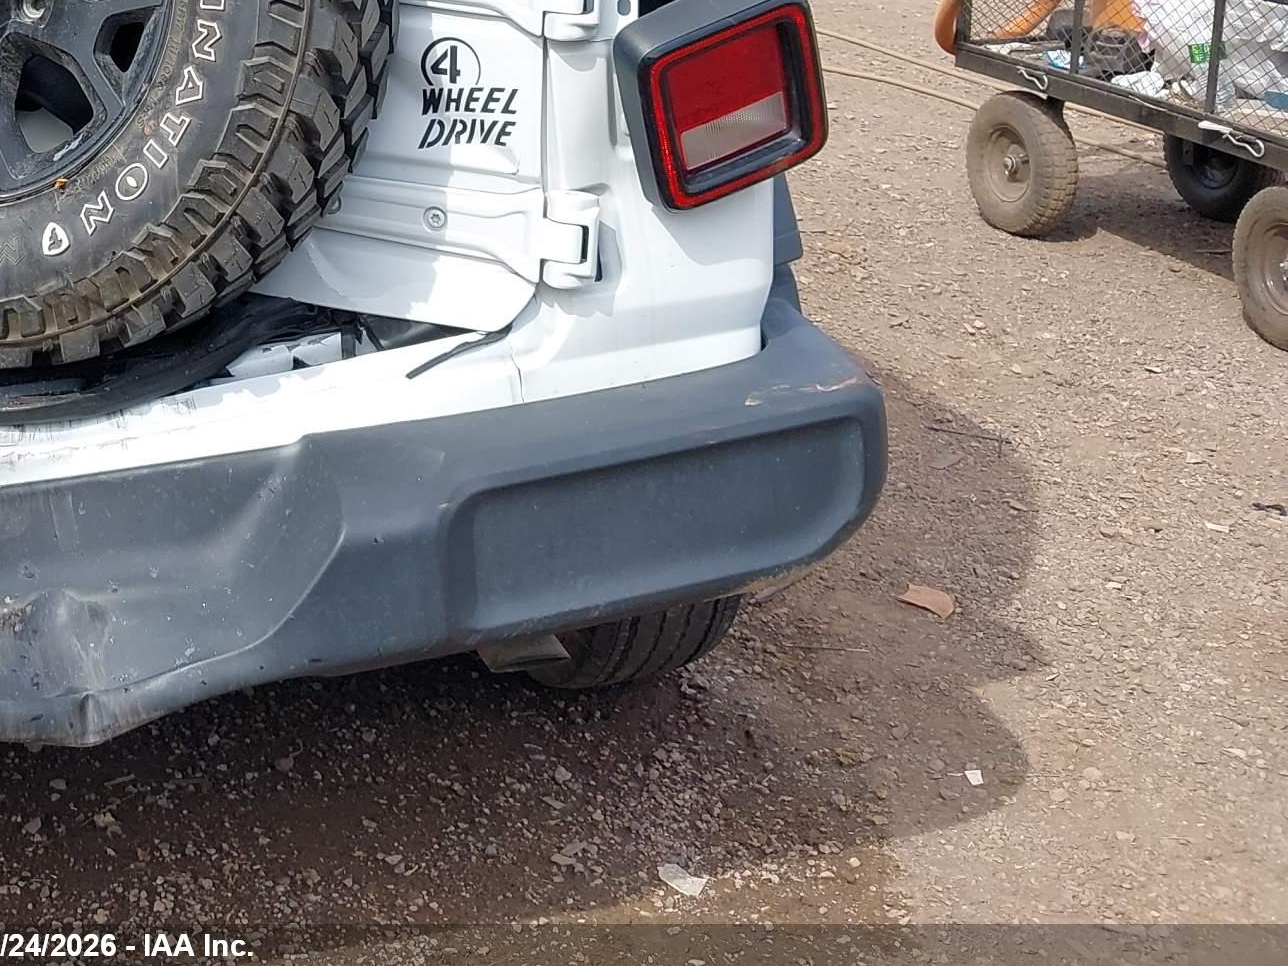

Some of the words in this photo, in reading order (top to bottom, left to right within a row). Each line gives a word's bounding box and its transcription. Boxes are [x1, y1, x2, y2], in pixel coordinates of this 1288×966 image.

[430, 45, 461, 84] 4
[421, 87, 519, 115] WHEEL
[417, 118, 517, 149] DRIVE
